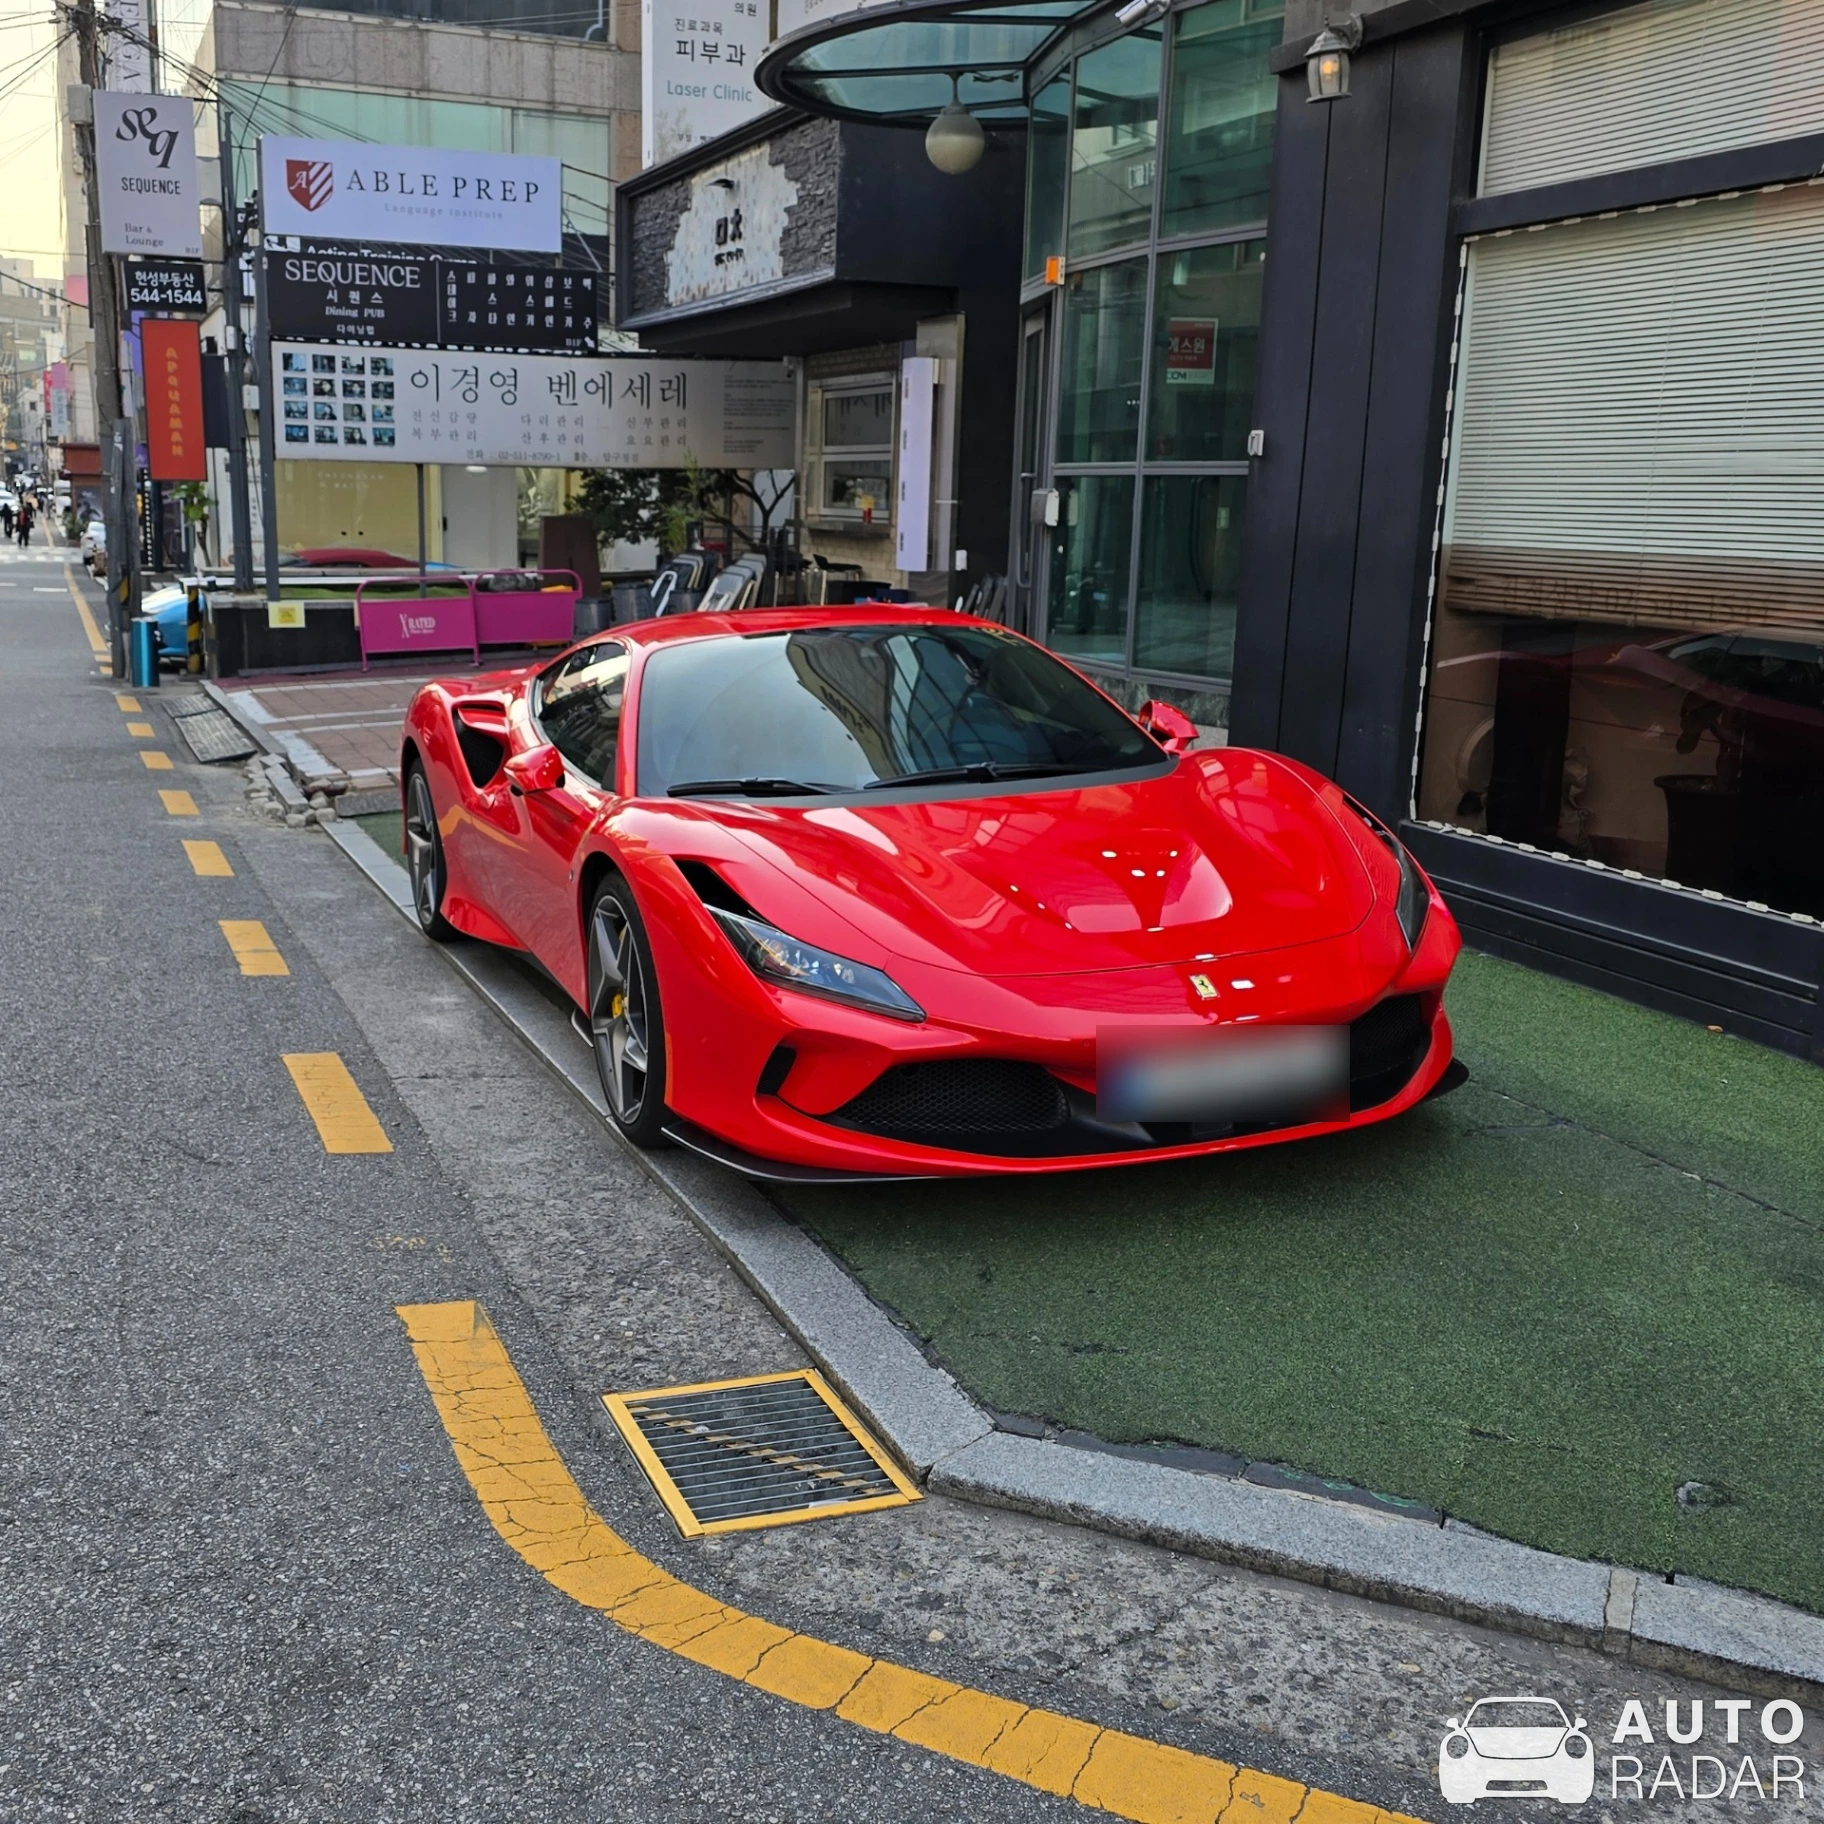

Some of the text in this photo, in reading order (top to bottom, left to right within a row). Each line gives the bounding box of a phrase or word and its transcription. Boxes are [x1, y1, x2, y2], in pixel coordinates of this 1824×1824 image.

[674, 18, 723, 36] 진료과목
[676, 39, 746, 67] 피부과
[667, 80, 753, 102] Laser Clinic
[121, 177, 181, 195] SEQUENCE
[346, 169, 539, 203] ABLE PREP
[384, 203, 443, 216] Language
[124, 223, 143, 234] Bar
[125, 235, 164, 247] Lounge
[285, 259, 421, 289] SEQUENCE
[130, 288, 203, 304] 544-1544
[325, 306, 385, 319] Dining PUB
[411, 363, 518, 406] 이경영
[547, 370, 687, 410] 벤에세레
[520, 413, 584, 428] 다리관리
